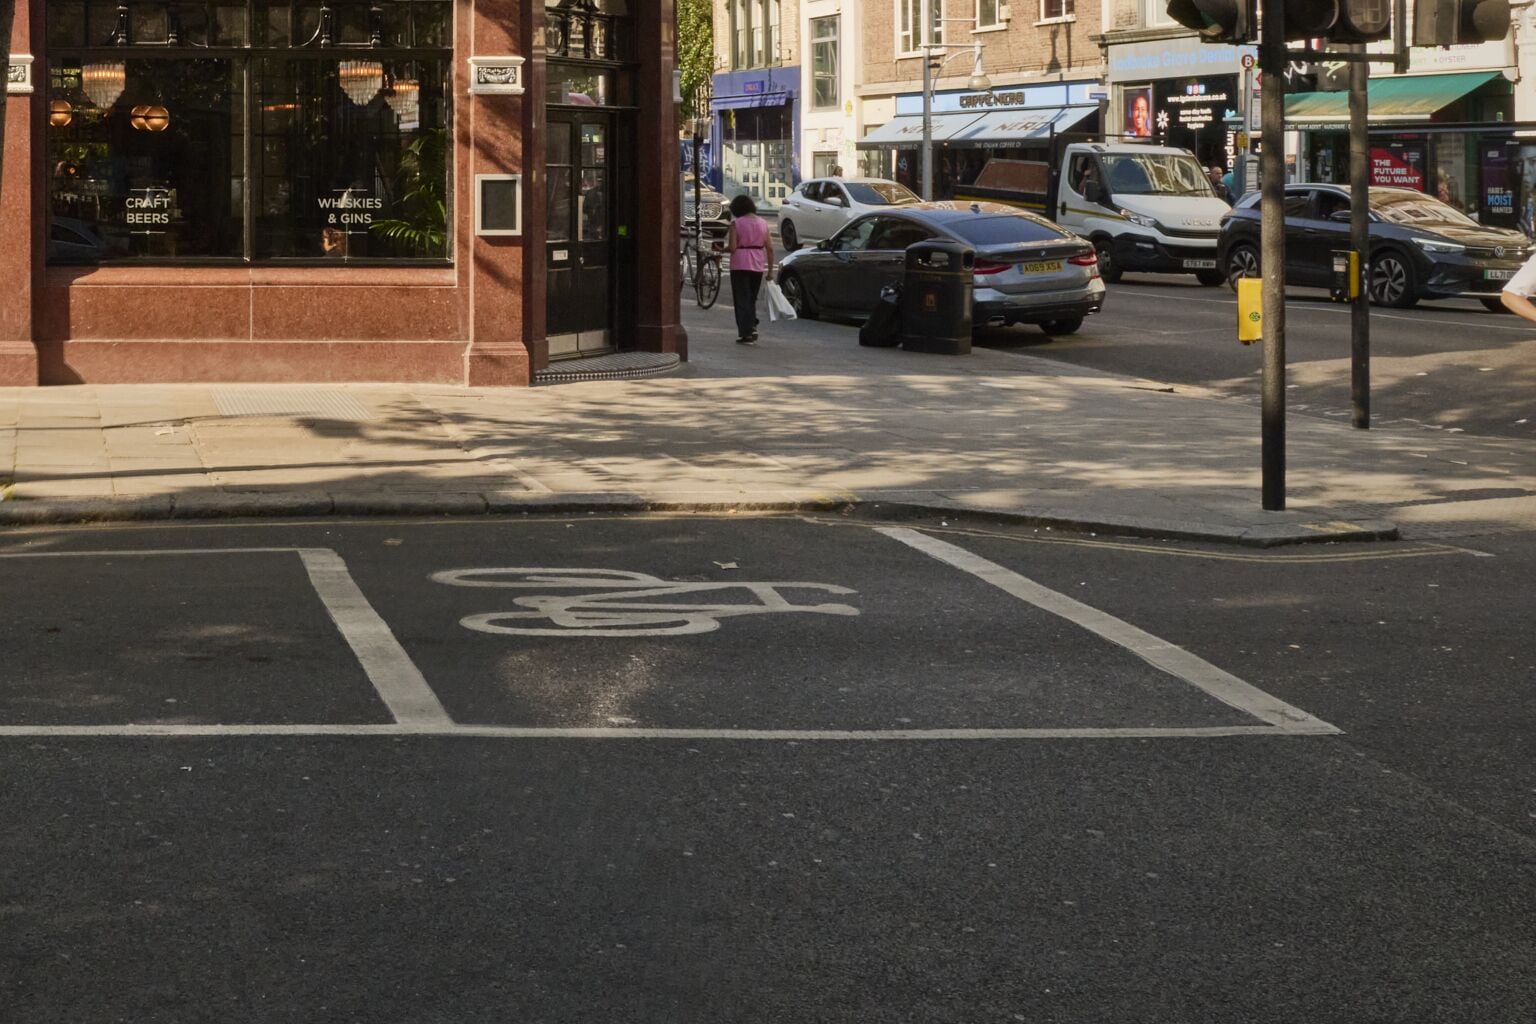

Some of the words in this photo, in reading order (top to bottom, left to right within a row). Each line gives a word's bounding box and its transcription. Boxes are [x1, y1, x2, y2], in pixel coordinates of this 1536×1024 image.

[1244, 56, 1252, 67] B
[1373, 159, 1391, 167] THE
[1393, 176, 1420, 184] WANT
[125, 197, 170, 209] CRAFT
[317, 197, 383, 209] WHISKIES
[1487, 195, 1512, 206] MOIST
[126, 212, 169, 224] BEERS
[327, 213, 337, 224] &
[340, 213, 372, 224] GINS
